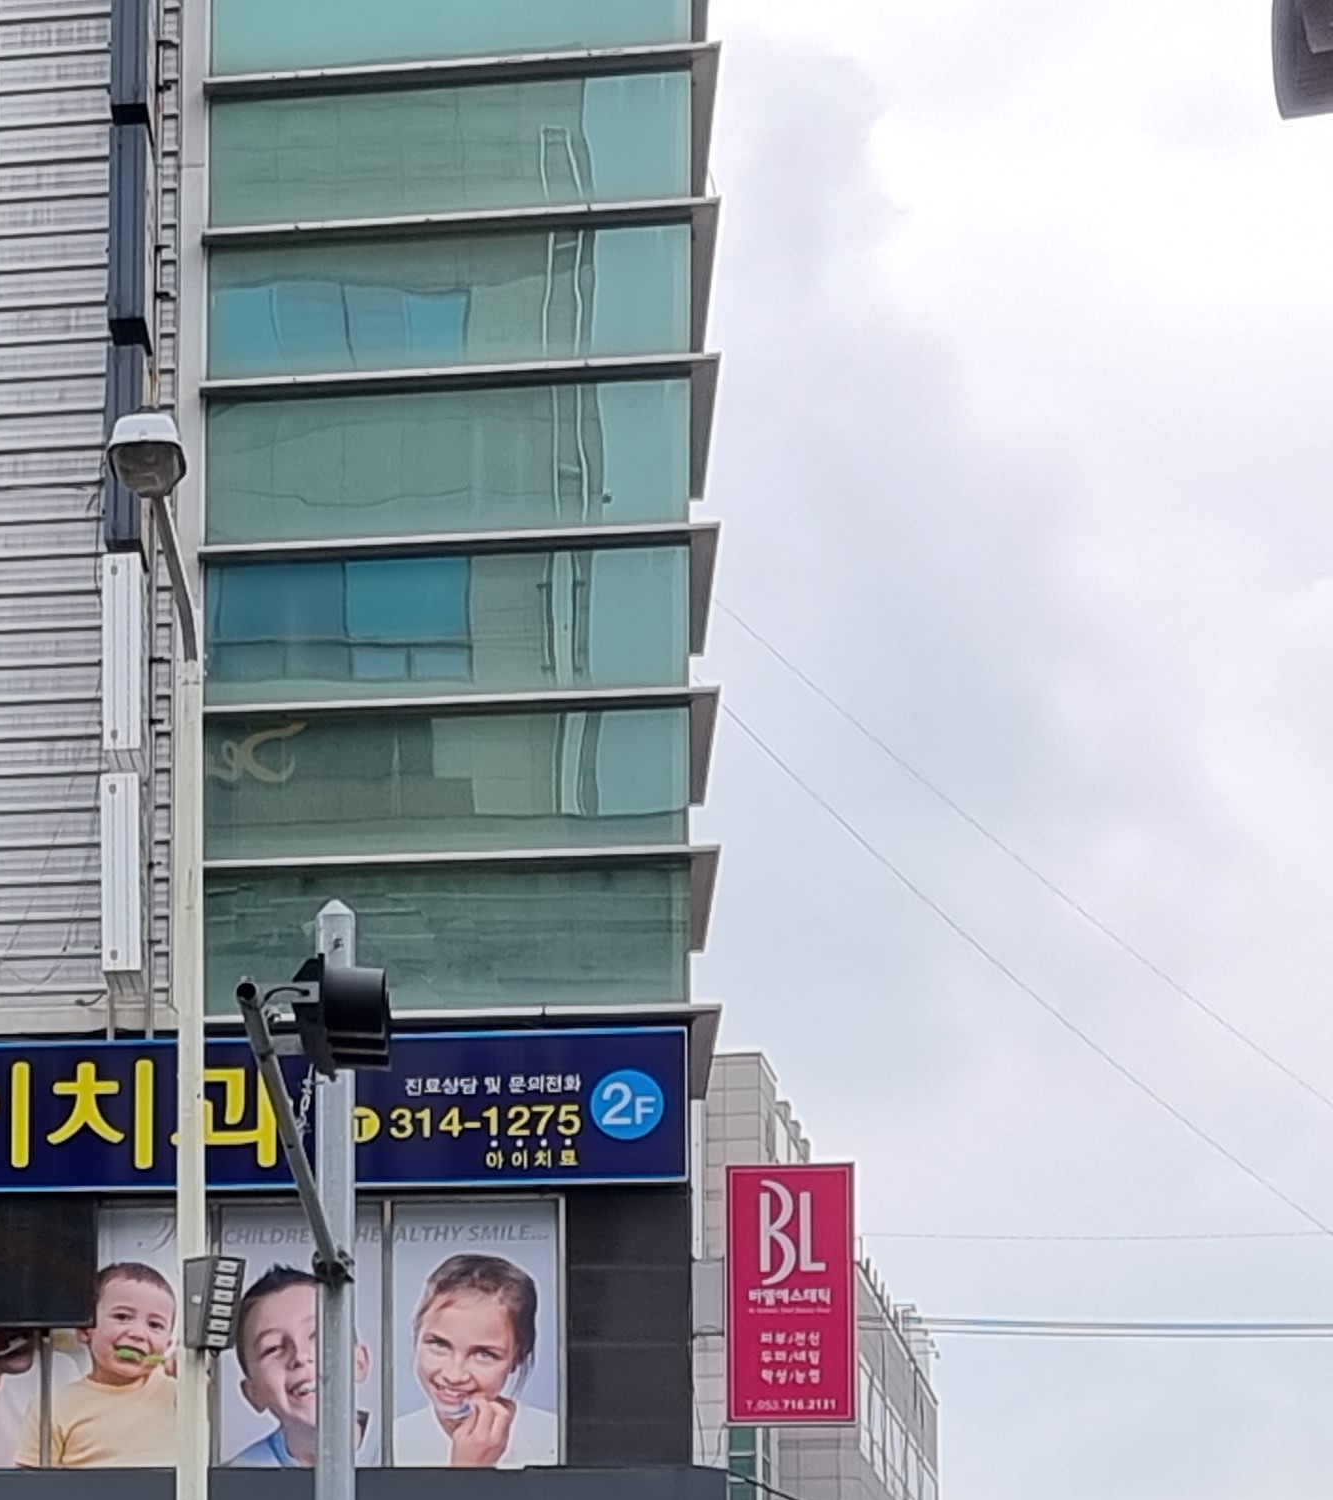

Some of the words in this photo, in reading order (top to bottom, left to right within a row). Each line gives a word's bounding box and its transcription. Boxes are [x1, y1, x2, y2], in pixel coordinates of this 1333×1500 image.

[405, 1077, 479, 1096] 진료상담
[484, 1076, 501, 1094] 및
[508, 1074, 582, 1093] 문의전화
[601, 1082, 655, 1125] 2F
[389, 1104, 581, 1139] 314-1275
[224, 1227, 313, 1245] CHILDRE
[759, 1180, 826, 1286] BL
